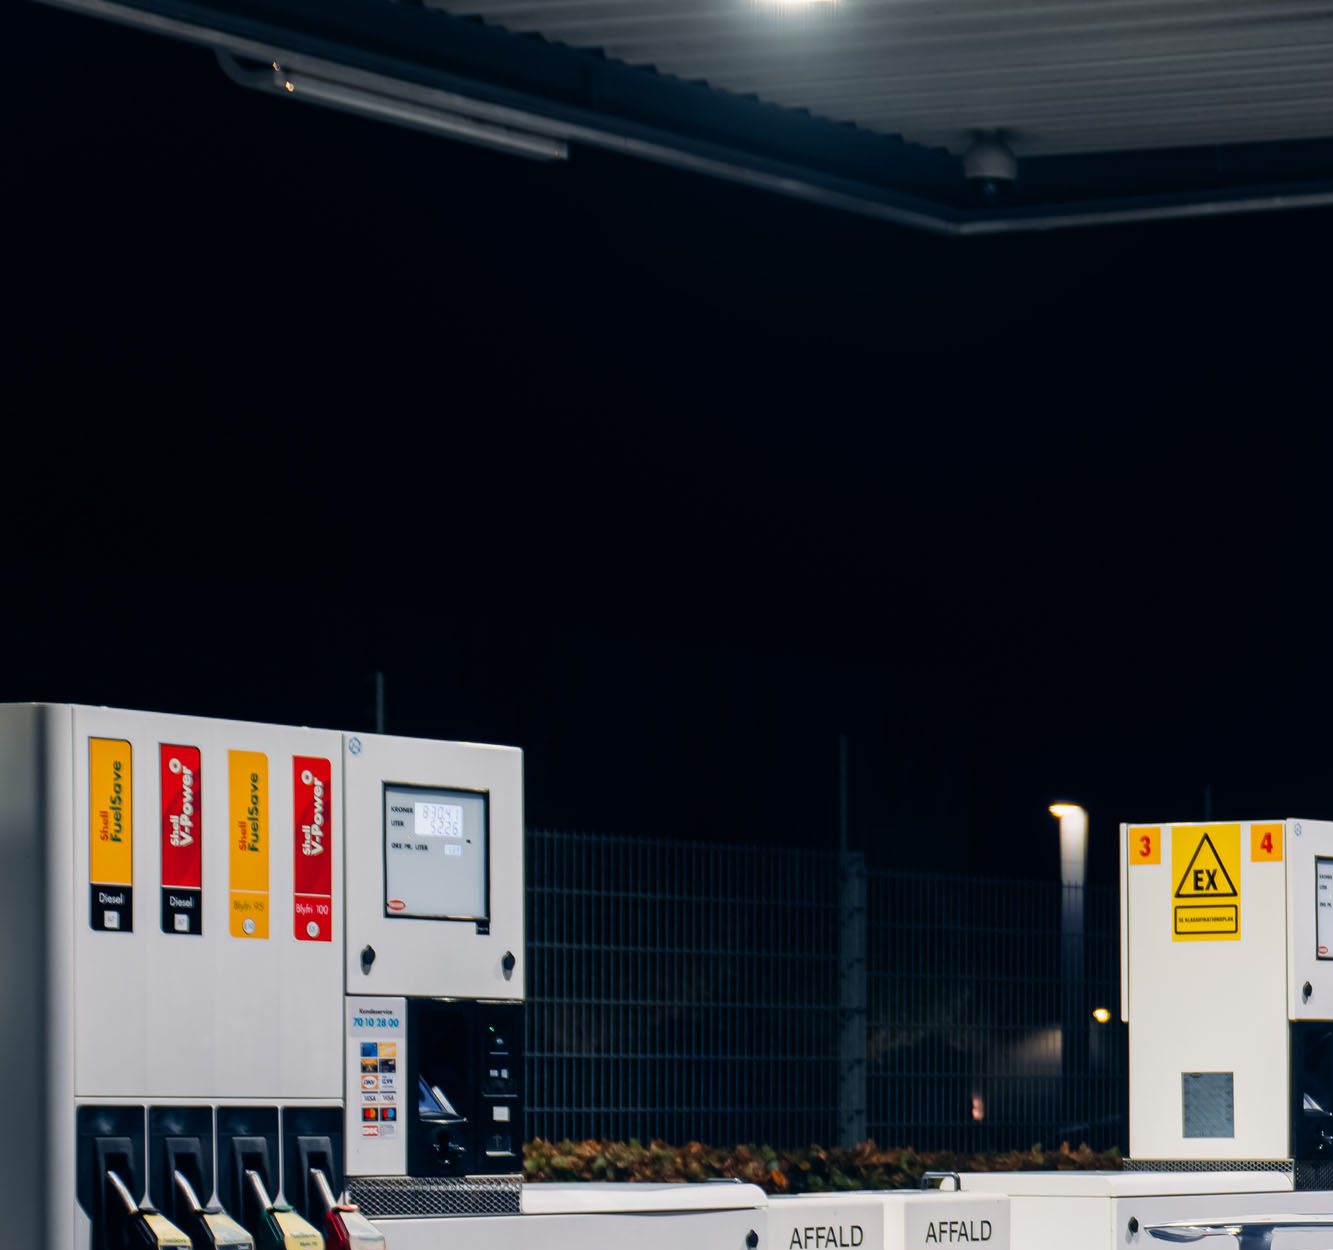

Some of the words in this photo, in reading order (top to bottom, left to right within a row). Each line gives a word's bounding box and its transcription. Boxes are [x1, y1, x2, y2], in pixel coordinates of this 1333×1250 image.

[110, 760, 122, 843] FuelSave
[179, 765, 194, 847] V-Power
[247, 773, 259, 853] FuelSave
[99, 810, 109, 842] Shell
[310, 777, 324, 857] V-Power
[169, 814, 180, 847] Shell
[238, 821, 247, 851] Shell
[302, 825, 311, 856] Shell
[1260, 831, 1273, 854] 4
[1138, 835, 1151, 857] 3
[1193, 869, 1218, 891] EX
[98, 891, 124, 905] Diesel
[169, 895, 193, 908] Diesel
[295, 904, 314, 915] Blyfri
[316, 904, 329, 915] 100
[353, 1017, 363, 1027] 70
[365, 1017, 374, 1027] 10
[388, 1017, 399, 1028] 00
[789, 1225, 864, 1250] AFFALD
[925, 1220, 993, 1244] AFFALD
